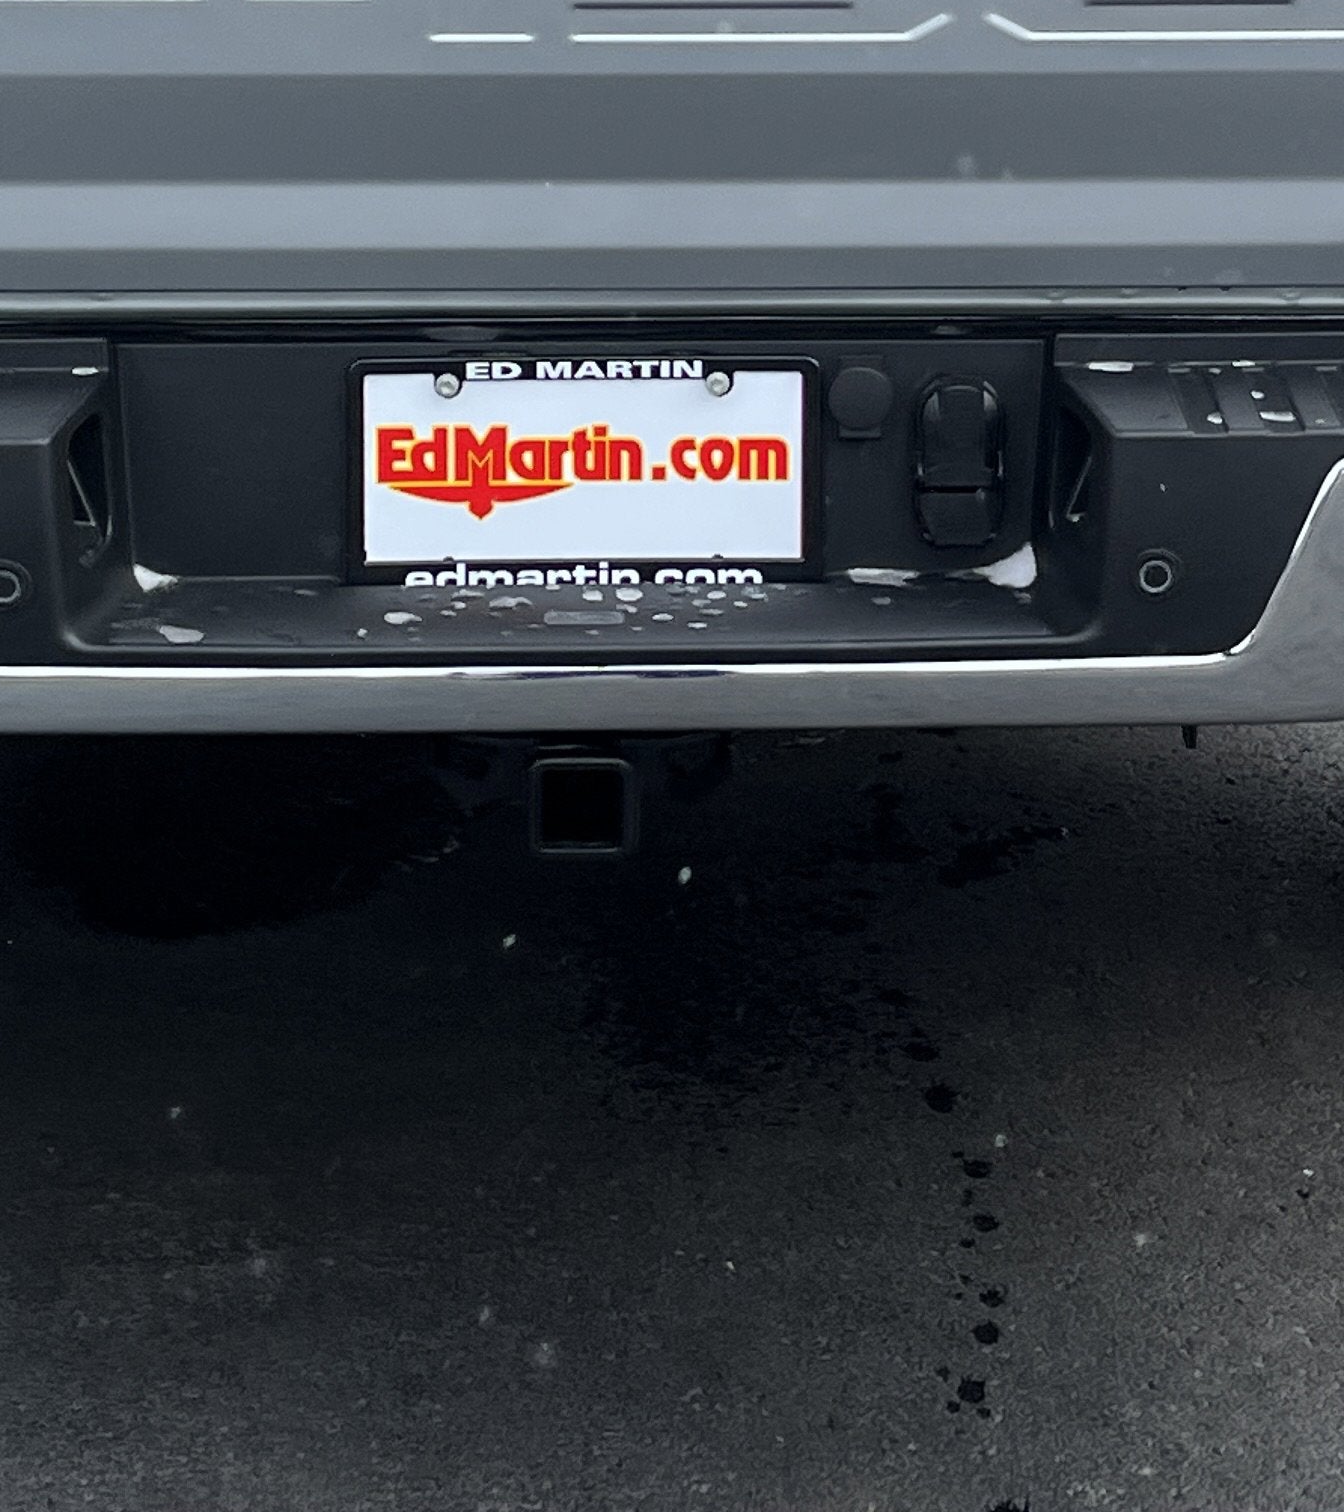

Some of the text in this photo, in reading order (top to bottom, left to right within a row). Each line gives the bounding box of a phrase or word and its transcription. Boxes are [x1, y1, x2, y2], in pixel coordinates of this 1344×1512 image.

[465, 360, 704, 380] ED MARTIN
[375, 423, 790, 483] EdMartin.com
[405, 561, 763, 587] edmartincom
